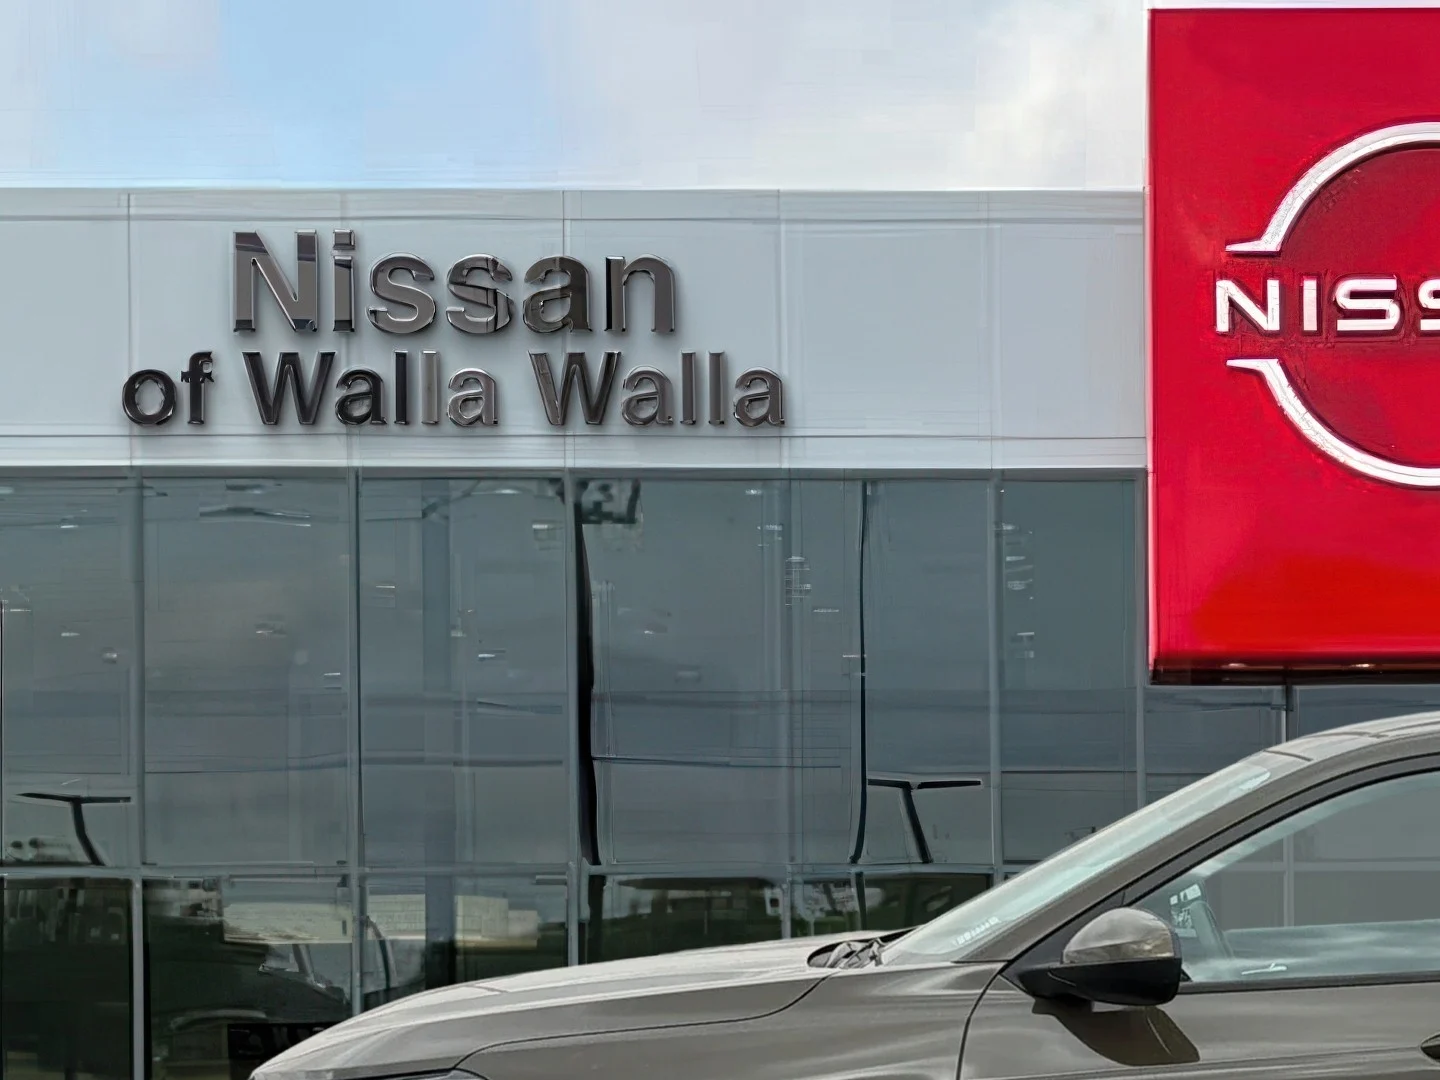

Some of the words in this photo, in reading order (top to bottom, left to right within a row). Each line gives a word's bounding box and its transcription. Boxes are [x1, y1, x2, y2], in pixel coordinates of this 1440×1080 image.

[232, 228, 676, 334] Nissan
[120, 350, 215, 427] of
[241, 349, 499, 427] Walla
[527, 349, 787, 427] Walla
